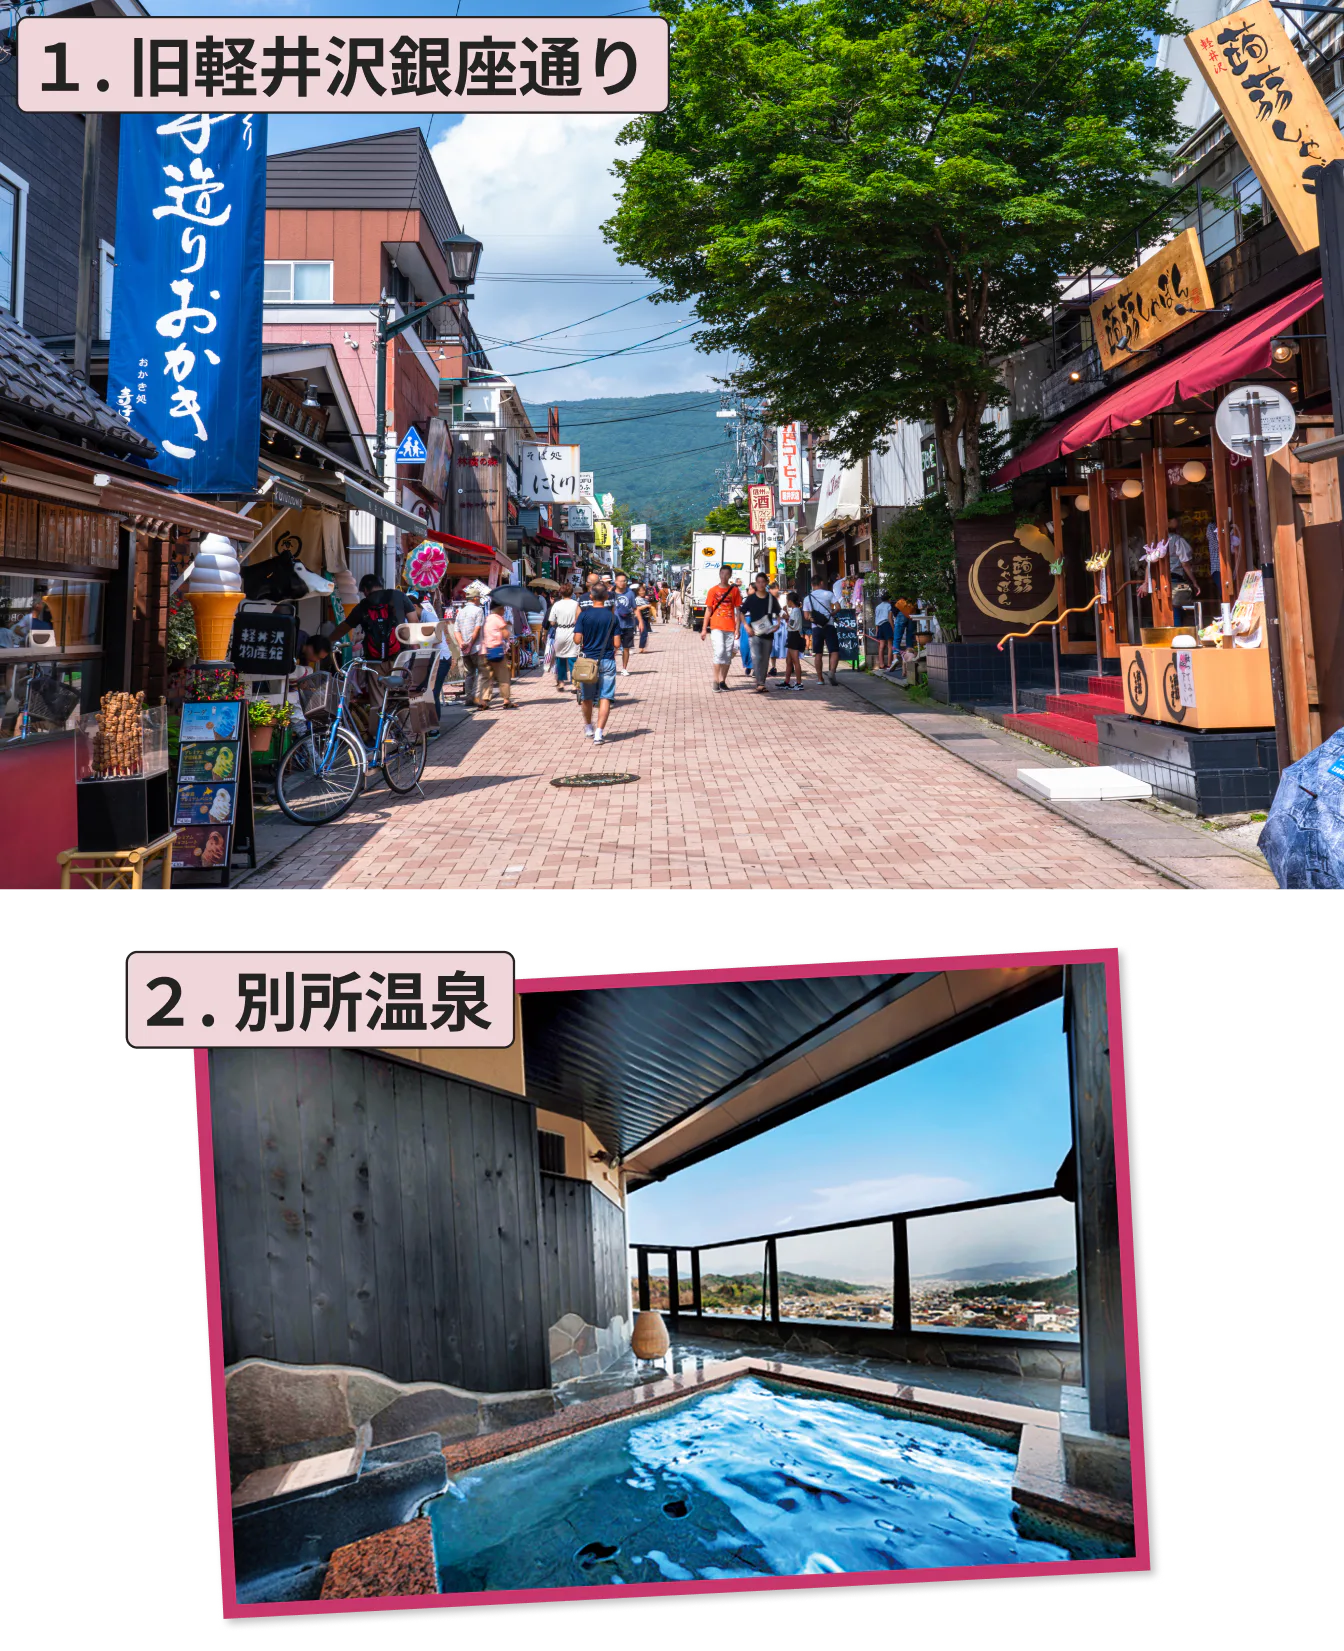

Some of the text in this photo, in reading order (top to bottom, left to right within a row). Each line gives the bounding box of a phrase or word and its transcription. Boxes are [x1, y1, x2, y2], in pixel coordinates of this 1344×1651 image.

[1199, 37, 1228, 75] 軽井沢
[135, 358, 149, 405] おかき処
[527, 451, 563, 461] そば処
[533, 474, 576, 495] にし川
[753, 495, 770, 509] 酒
[241, 628, 285, 645] 軽井沢
[239, 644, 284, 661] 物産館
